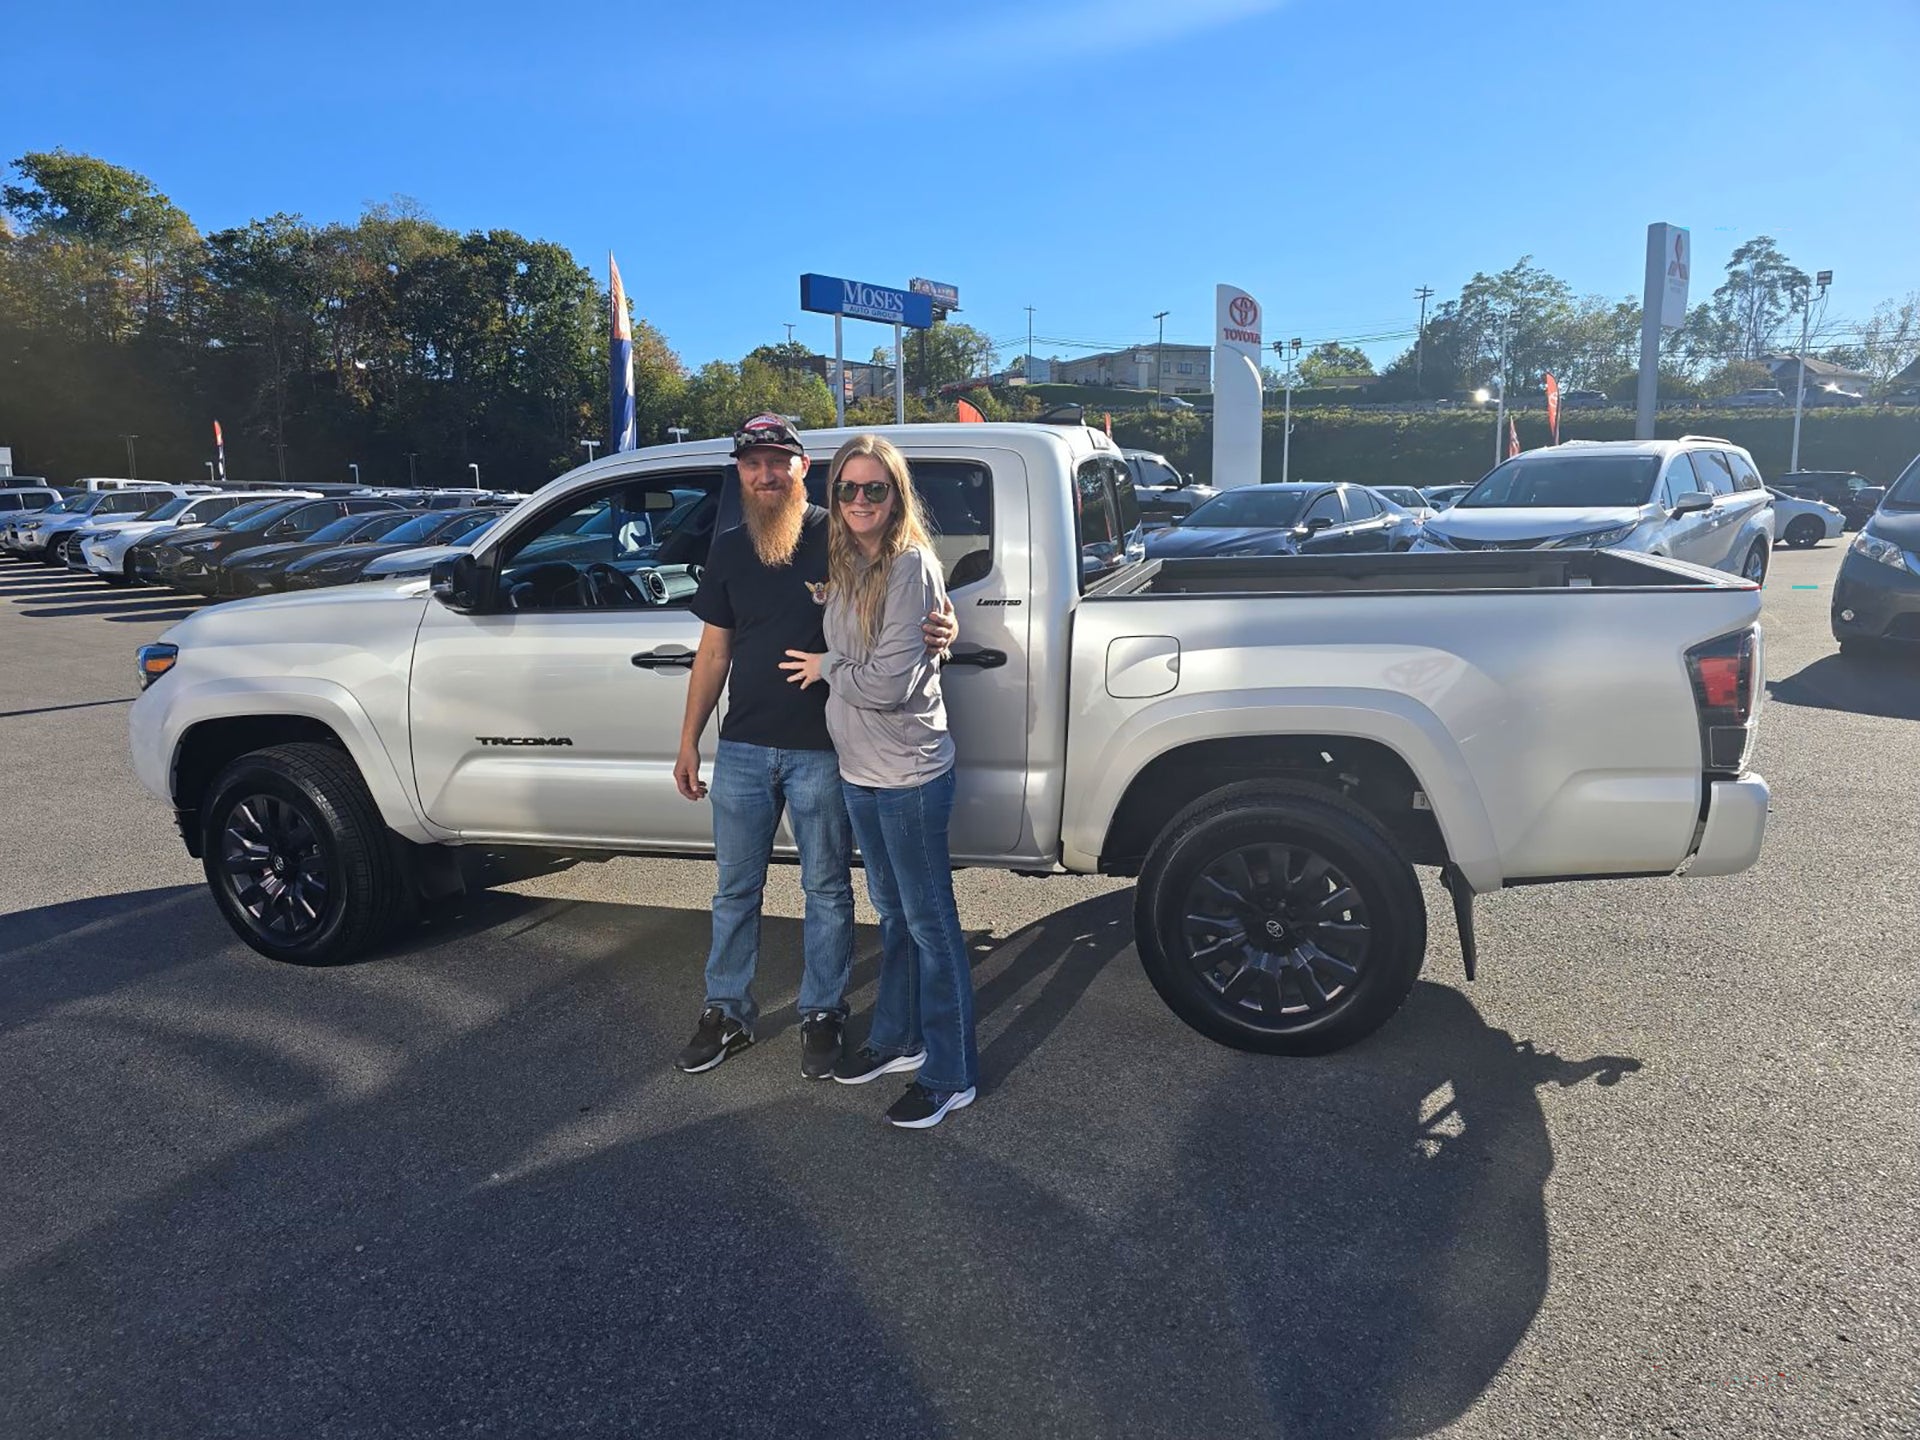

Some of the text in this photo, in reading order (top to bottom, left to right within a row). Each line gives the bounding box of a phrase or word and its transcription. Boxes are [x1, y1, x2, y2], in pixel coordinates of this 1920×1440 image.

[843, 280, 904, 312] MOSES
[849, 305, 897, 319] AUTO GROUP
[1223, 327, 1261, 345] TOYOTA
[475, 736, 573, 746] TACOMA
